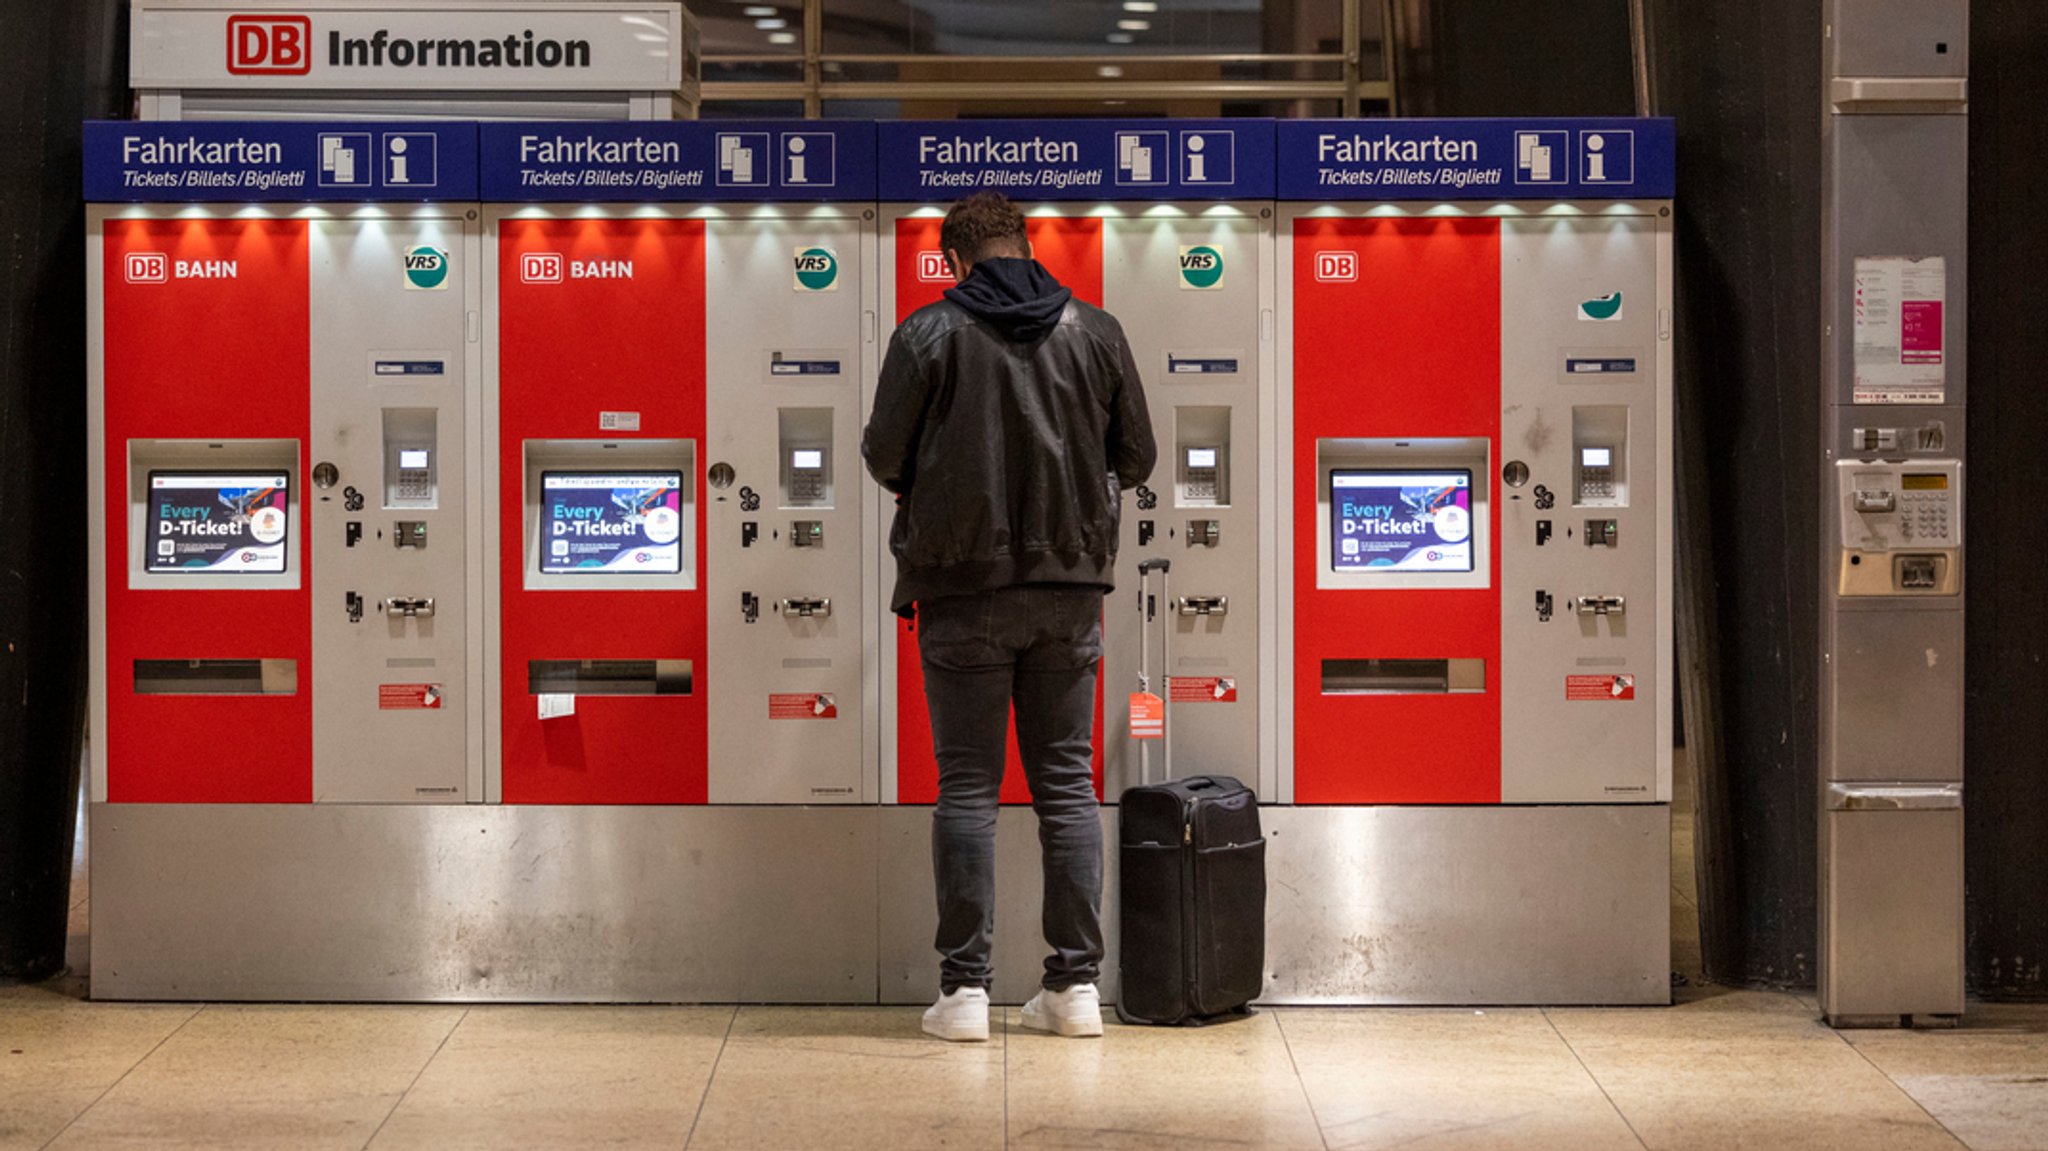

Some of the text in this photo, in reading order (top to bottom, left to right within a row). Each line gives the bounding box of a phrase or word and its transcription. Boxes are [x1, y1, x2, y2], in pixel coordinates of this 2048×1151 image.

[236, 25, 591, 67] DB Information
[124, 137, 281, 163] Fahrkarten
[522, 136, 679, 162] Fahrkarten
[921, 136, 1078, 162] Fahrkarten
[1320, 135, 1478, 161] Fahrkarten
[132, 259, 238, 279] DB BAHN
[405, 256, 437, 269] VRS
[528, 259, 634, 279] DB BAHN
[794, 257, 826, 270] VRS
[1180, 255, 1212, 268] VRS
[1322, 258, 1351, 276] DB
[160, 504, 211, 521] Every
[553, 504, 604, 521] Every
[1342, 503, 1393, 520] Every
[159, 520, 242, 535] D-Ticket!
[553, 520, 636, 535] D-Ticket!
[1342, 519, 1426, 535] D-Ticket!
